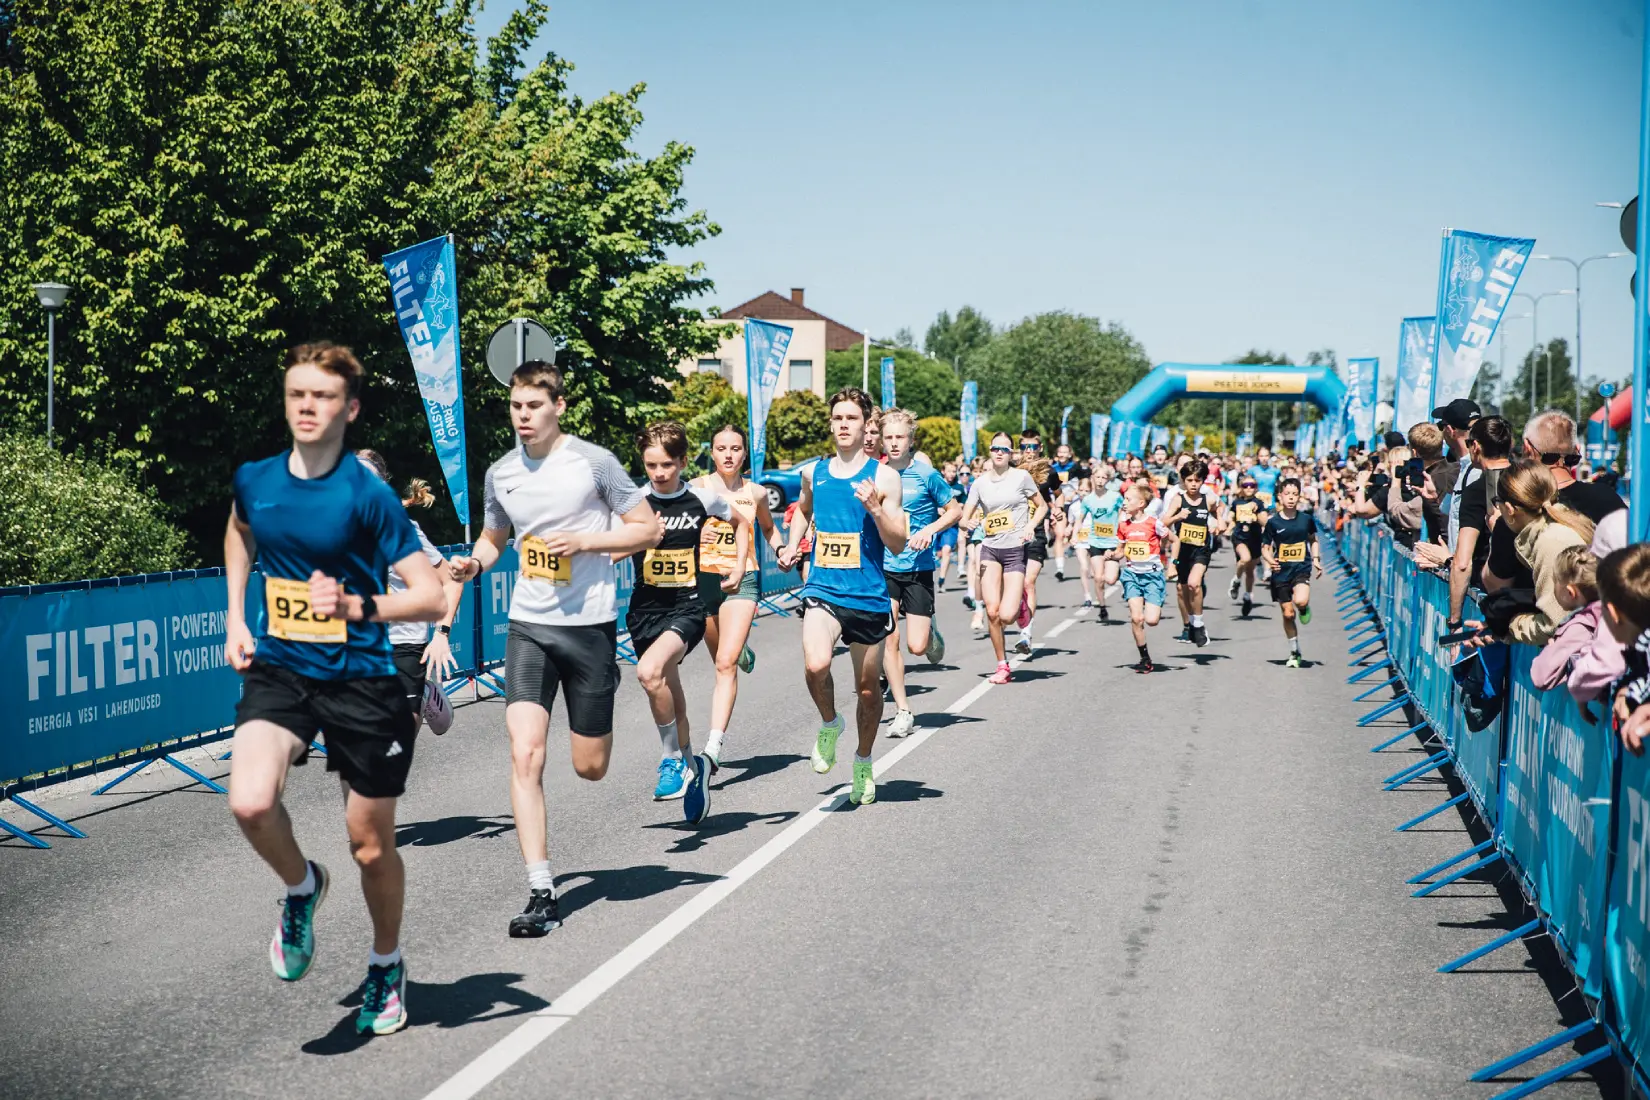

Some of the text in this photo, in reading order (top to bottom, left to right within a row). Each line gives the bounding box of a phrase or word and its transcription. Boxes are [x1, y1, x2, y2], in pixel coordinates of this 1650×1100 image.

[660, 511, 701, 530] wix
[987, 516, 1009, 529] 292
[716, 532, 735, 545] 78
[1183, 528, 1205, 540] 1109
[822, 542, 852, 558] 797
[1127, 546, 1146, 556] 755
[1282, 548, 1303, 557] 807
[527, 548, 560, 572] 818
[651, 560, 689, 576] 935
[171, 609, 229, 640] POWERIN
[26, 619, 160, 702] FILTER
[173, 646, 209, 674] YOUR
[28, 693, 161, 735] ENERGIA VESI LAHENDUSED
